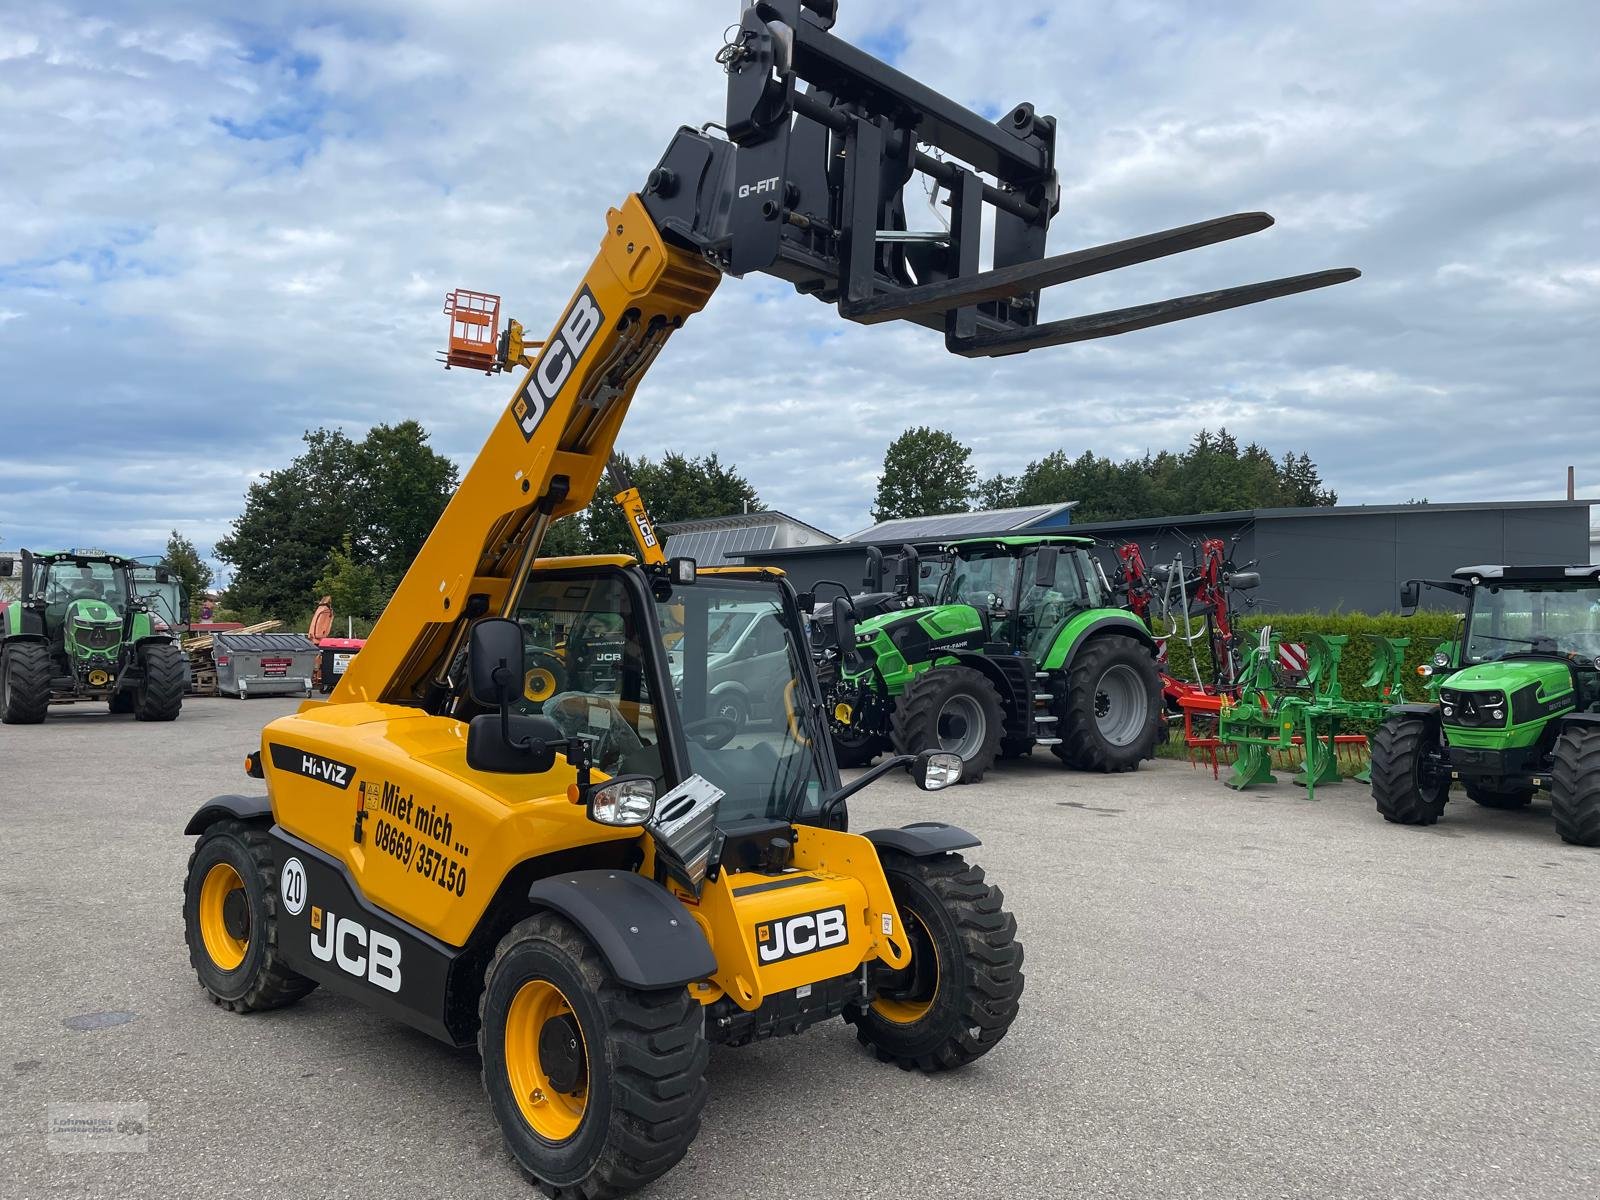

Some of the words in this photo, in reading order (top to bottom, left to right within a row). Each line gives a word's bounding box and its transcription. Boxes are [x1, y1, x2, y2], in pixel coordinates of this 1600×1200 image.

[738, 176, 780, 199] Q-FIT
[521, 294, 600, 434] JCB
[635, 514, 656, 548] JCB
[596, 653, 622, 661] JCB
[929, 641, 968, 651] TZ-FAHR
[380, 780, 414, 825] Miet
[414, 804, 453, 847] mich
[375, 819, 467, 898] 08669/357150
[286, 868, 301, 904] 20
[310, 911, 402, 993] JCB
[759, 909, 846, 962] JCB
